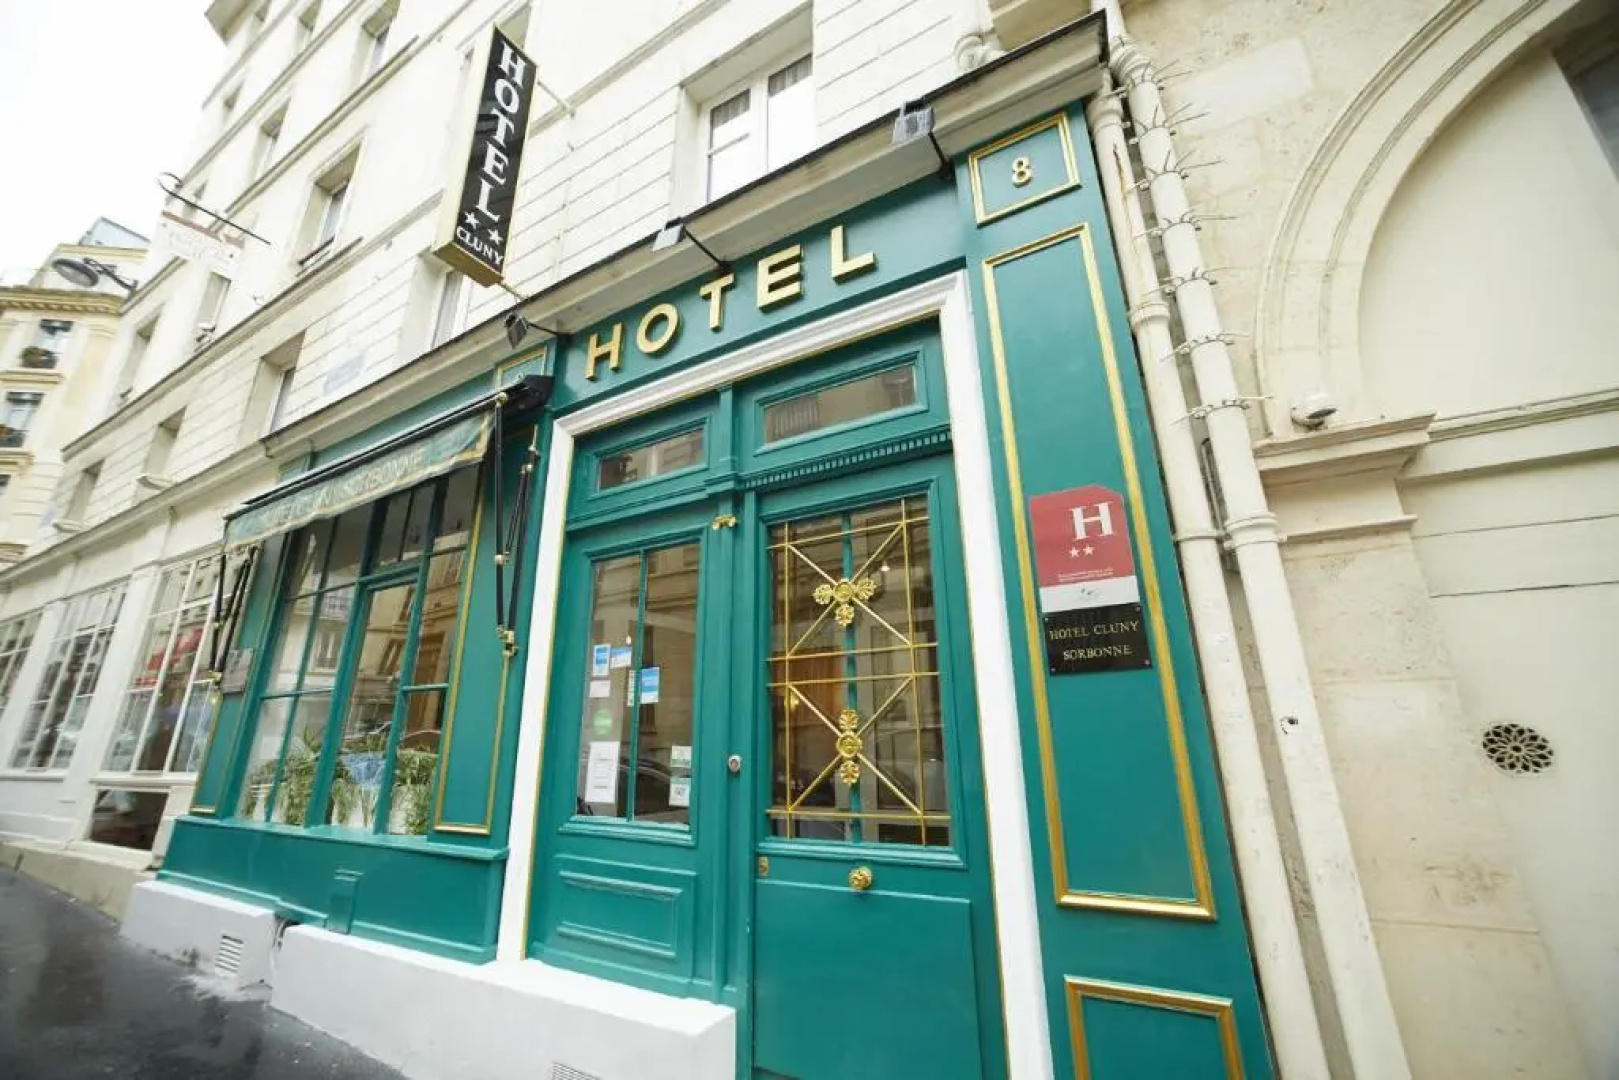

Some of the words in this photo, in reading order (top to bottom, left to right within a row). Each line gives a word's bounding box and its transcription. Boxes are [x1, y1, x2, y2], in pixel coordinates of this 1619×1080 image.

[476, 41, 528, 222] HOTEL
[1012, 157, 1033, 188] 8
[456, 225, 504, 265] CLUNY
[585, 225, 878, 380] HOTEL
[1069, 500, 1115, 541] H
[1049, 626, 1089, 640] HOTEL
[1093, 620, 1139, 635] CLUNY
[1063, 645, 1132, 660] SORBONNE
